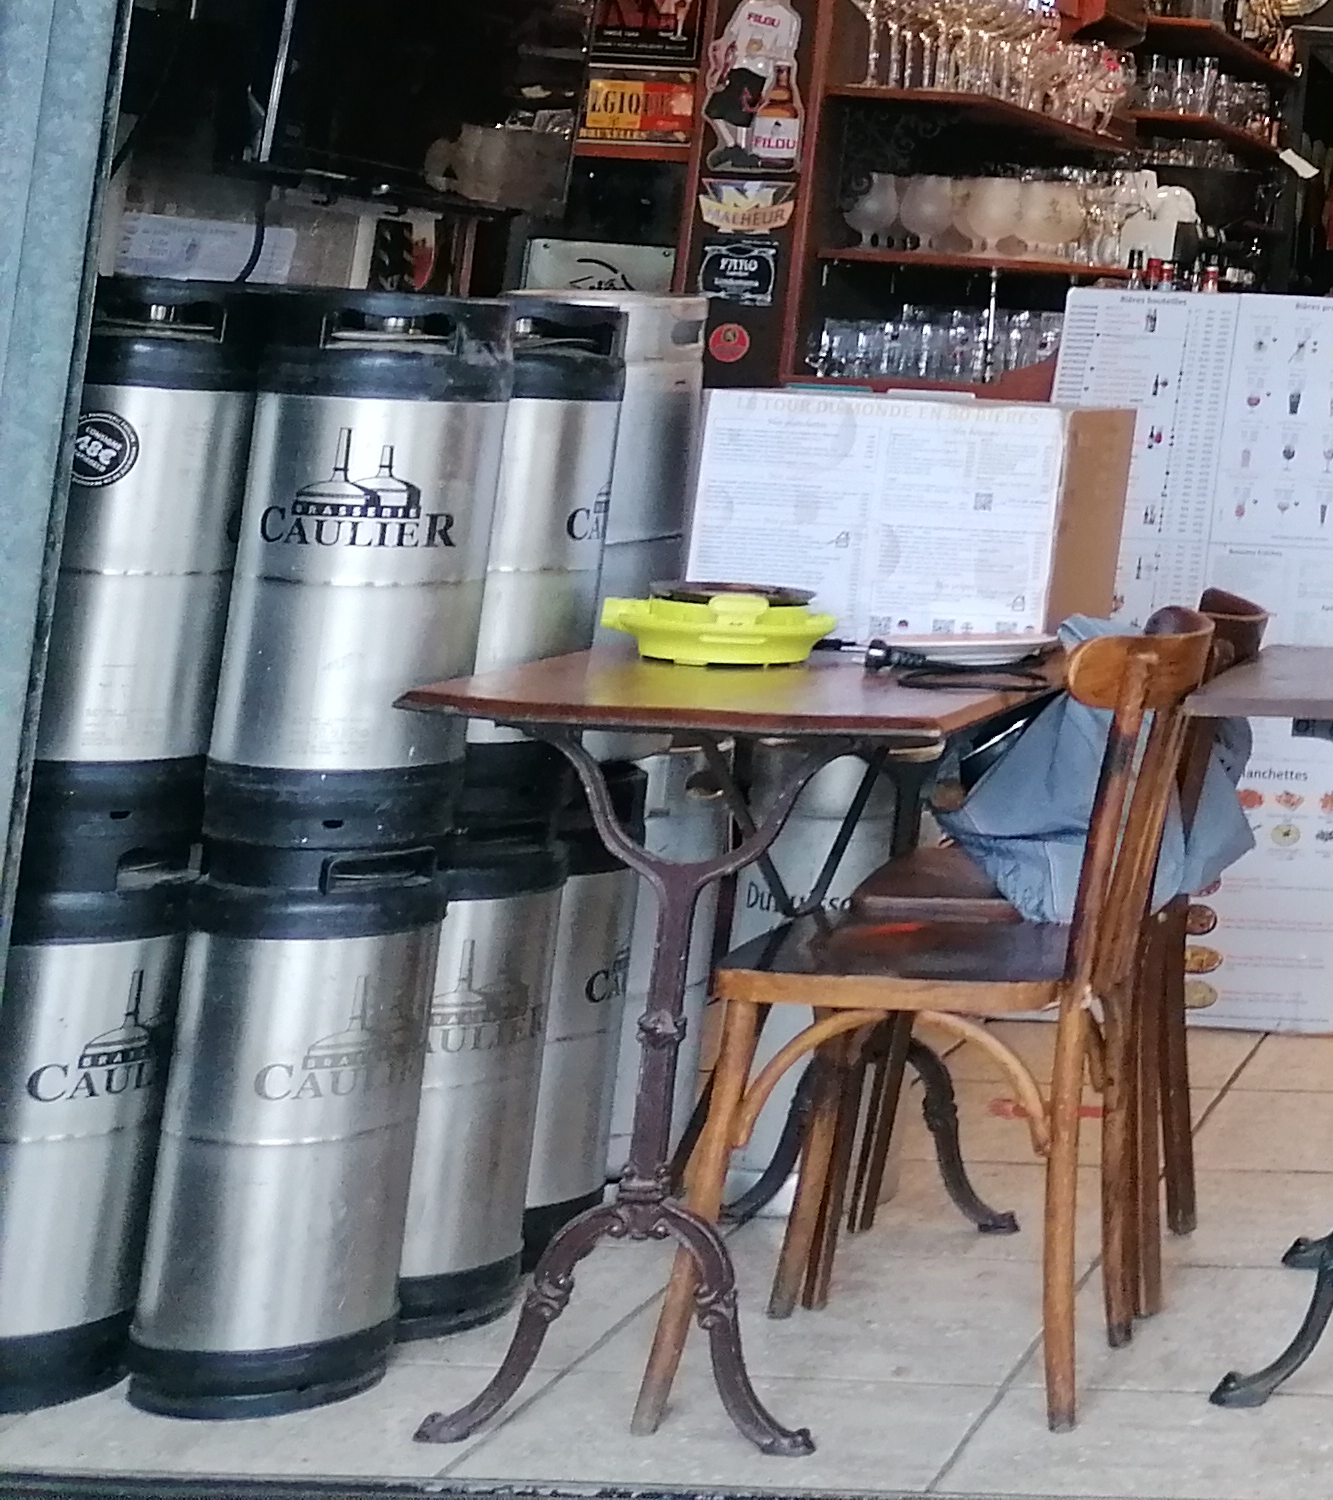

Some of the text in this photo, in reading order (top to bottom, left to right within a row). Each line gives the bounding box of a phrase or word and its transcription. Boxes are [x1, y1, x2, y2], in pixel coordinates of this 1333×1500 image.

[747, 11, 780, 28] FILOU
[753, 135, 796, 150] FILOU
[260, 505, 457, 549] CAULIER
[1240, 766, 1308, 782] lanchettes
[27, 1063, 155, 1103] CAUL
